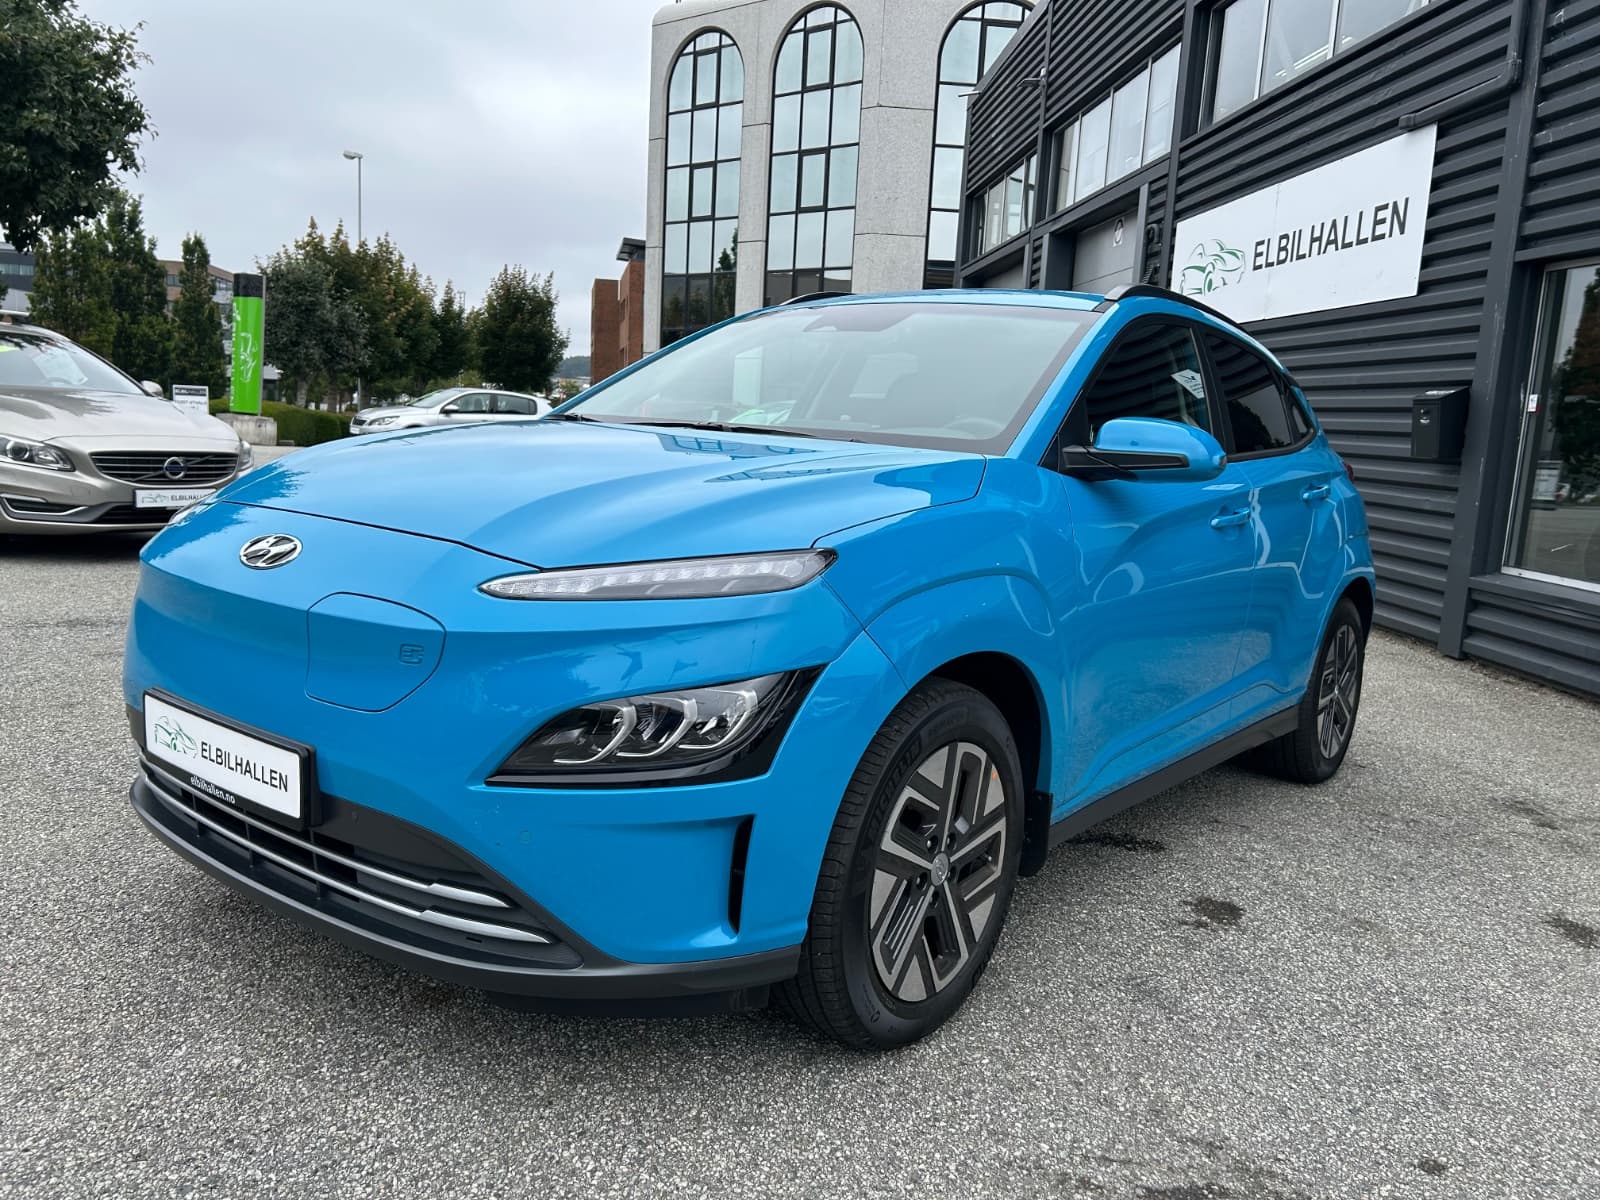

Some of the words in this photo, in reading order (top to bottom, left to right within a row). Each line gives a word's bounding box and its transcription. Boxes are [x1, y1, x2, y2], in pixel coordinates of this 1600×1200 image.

[1252, 197, 1409, 271] ELBILHALLEN
[190, 775, 236, 804] elbilhallen.no
[201, 741, 288, 792] ELBILHALLEN
